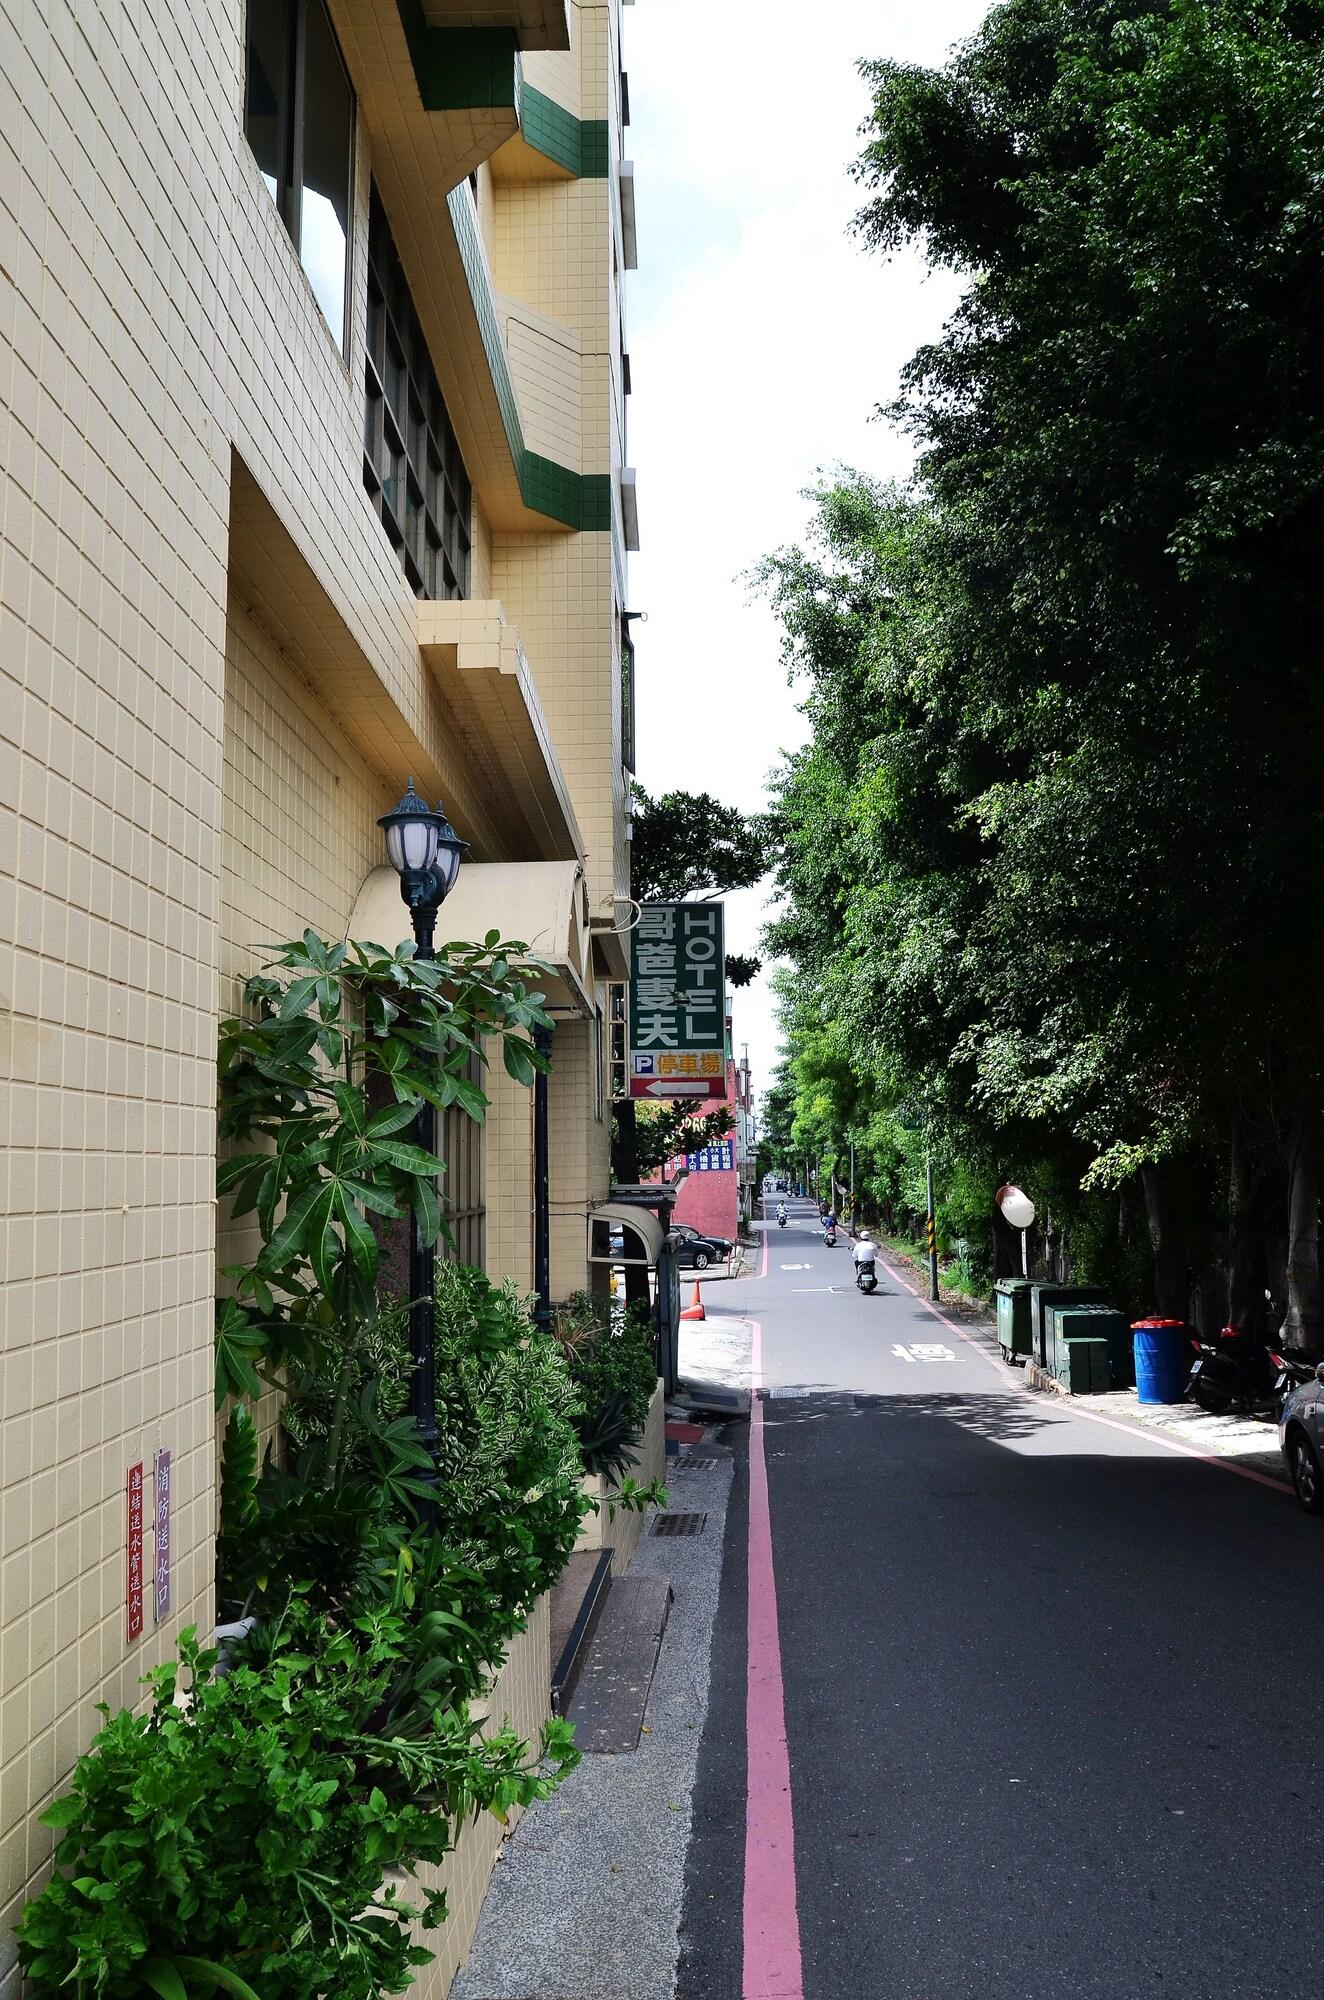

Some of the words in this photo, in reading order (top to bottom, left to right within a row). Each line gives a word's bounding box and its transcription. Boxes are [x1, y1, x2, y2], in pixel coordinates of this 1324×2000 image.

[636, 907, 678, 1046] 哥爸妻夫
[685, 911, 717, 1039] HOTEL
[636, 1056, 652, 1073] P
[658, 1053, 719, 1074] 停車場
[130, 1470, 142, 1631] 連結送水管送水口
[158, 1466, 169, 1606] 消防送水口
